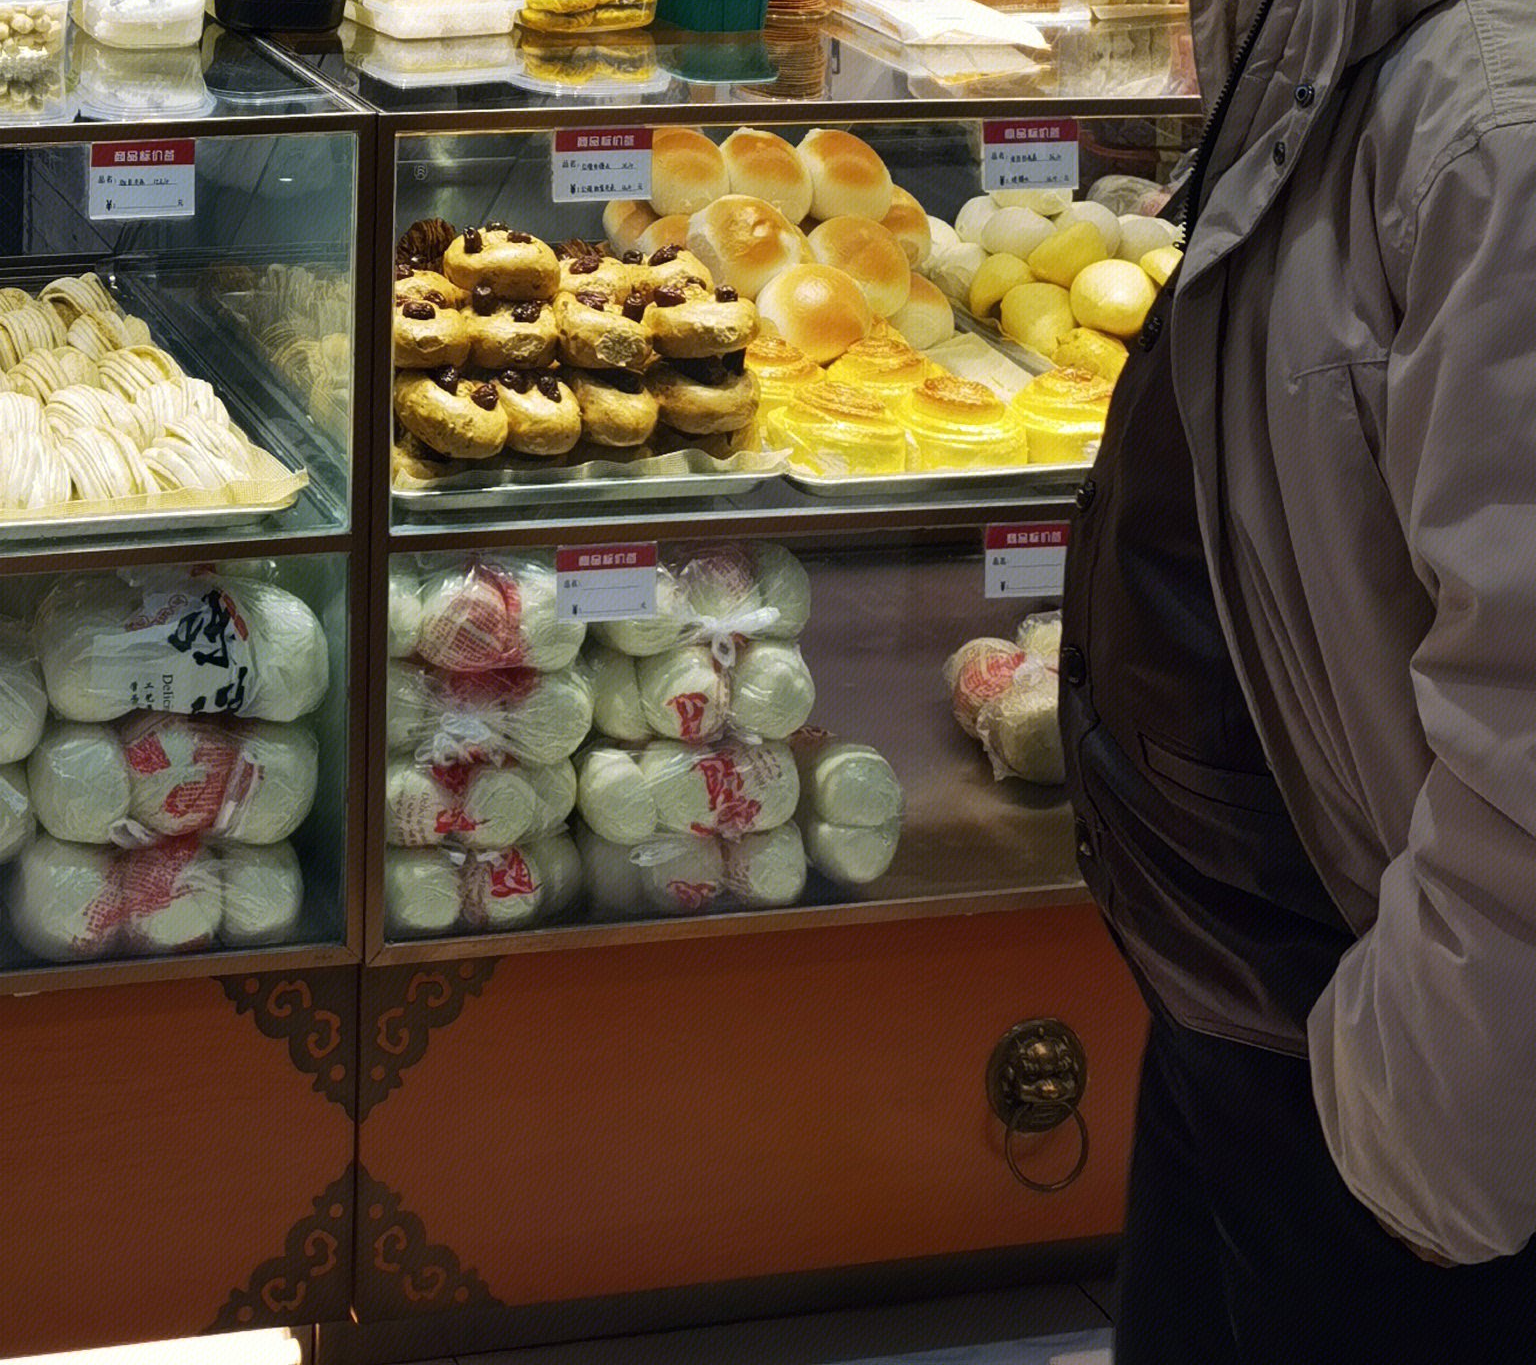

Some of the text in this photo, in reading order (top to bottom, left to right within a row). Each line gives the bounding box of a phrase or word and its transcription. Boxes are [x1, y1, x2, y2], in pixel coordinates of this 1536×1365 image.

[113, 149, 175, 163] 商品标价签
